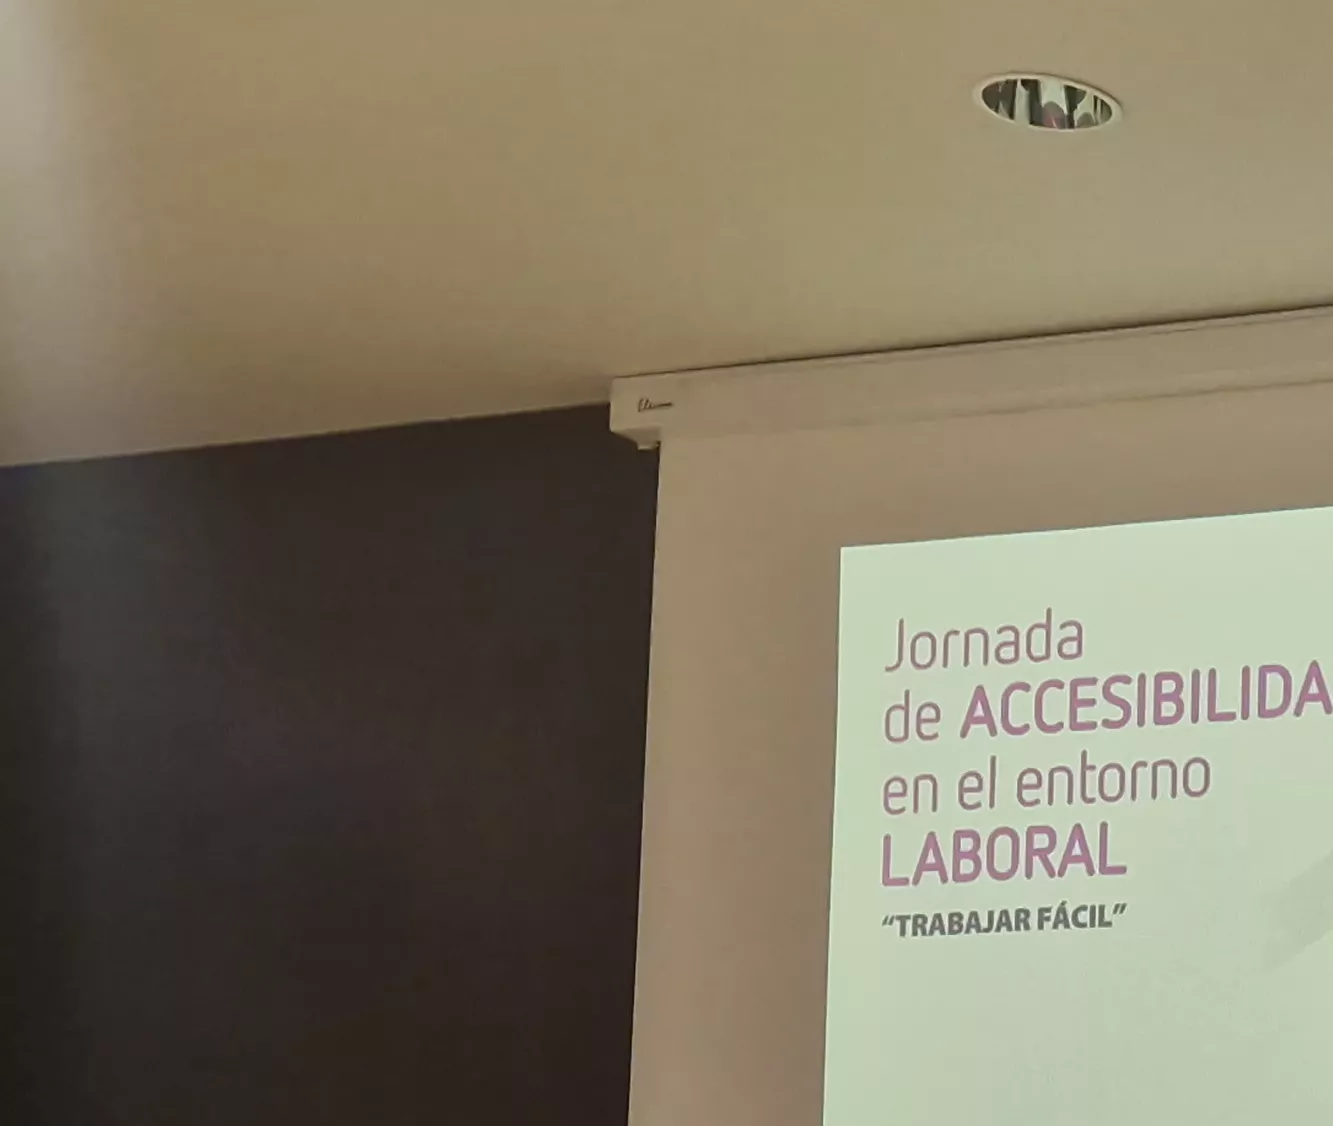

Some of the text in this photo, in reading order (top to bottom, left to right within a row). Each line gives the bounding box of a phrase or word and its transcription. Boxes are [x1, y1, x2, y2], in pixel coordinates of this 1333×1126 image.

[885, 607, 1084, 673] Jornada
[885, 690, 942, 744] de
[883, 749, 1211, 815] en el entorno
[881, 821, 1127, 887] LABORAL
